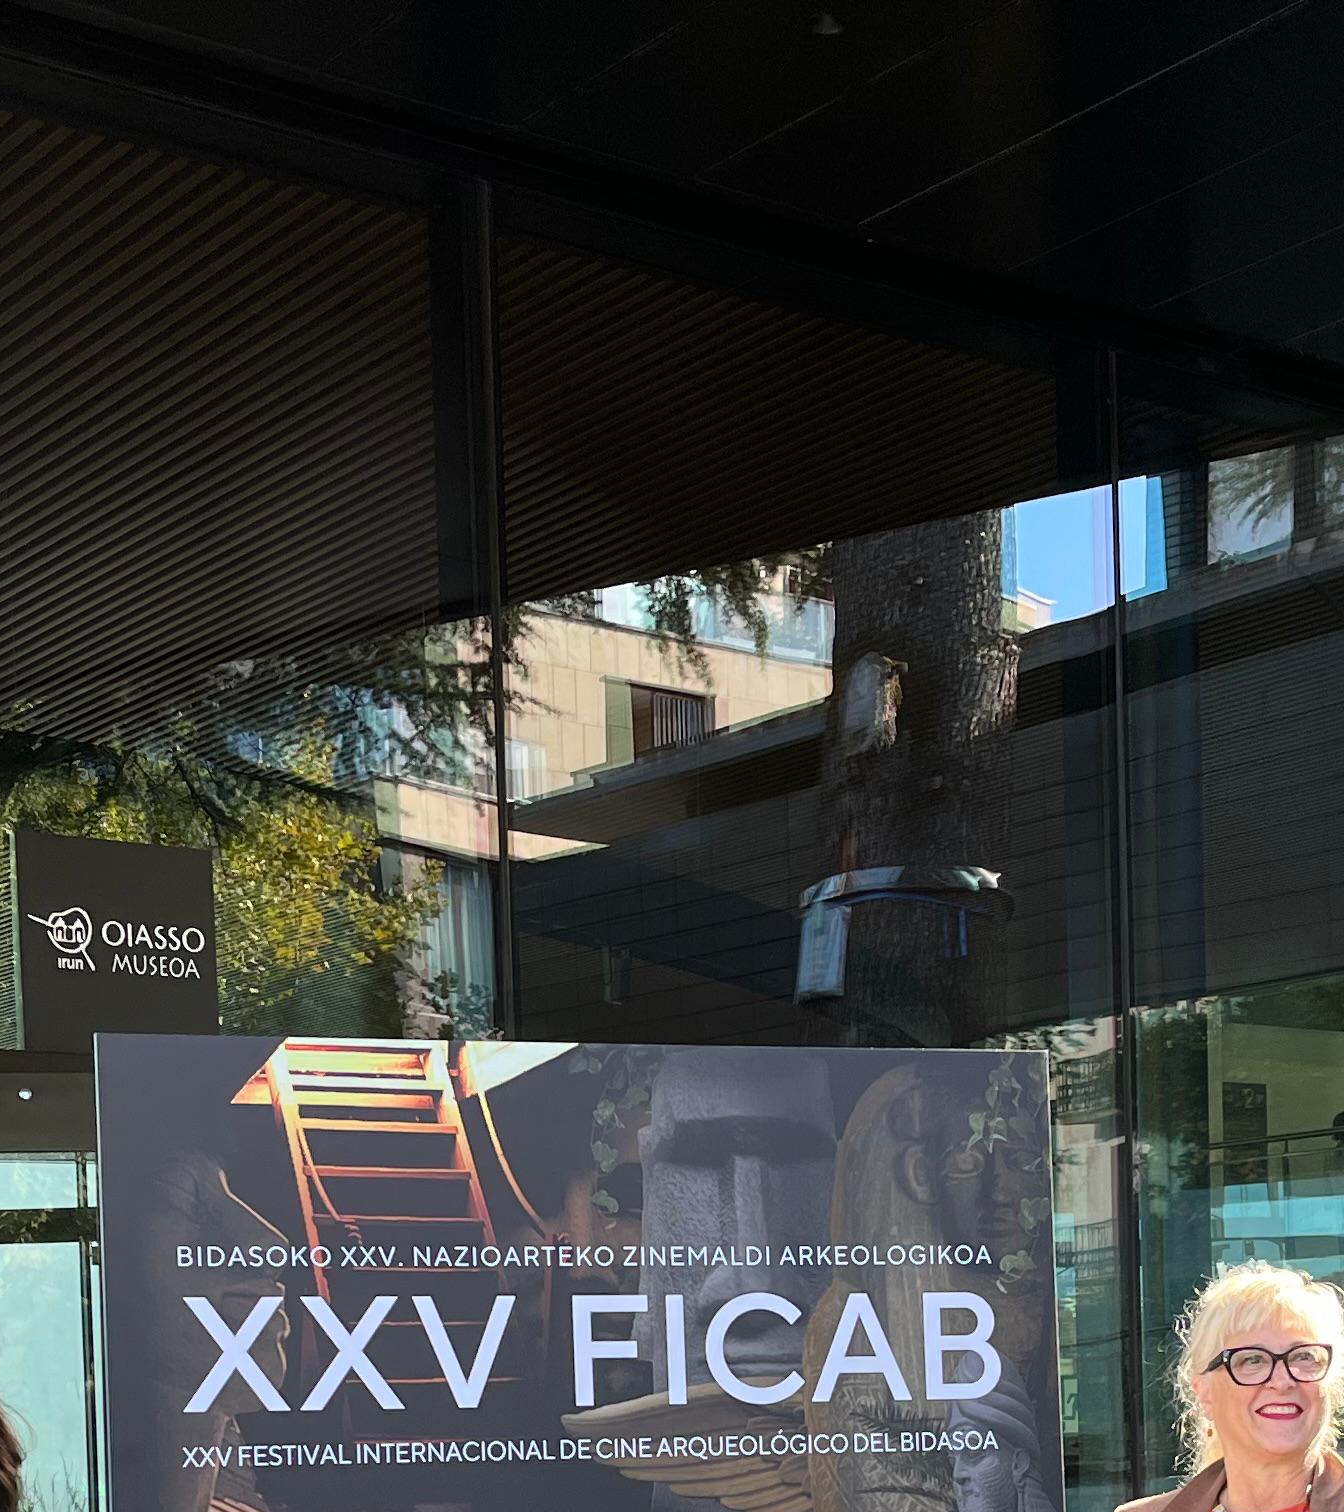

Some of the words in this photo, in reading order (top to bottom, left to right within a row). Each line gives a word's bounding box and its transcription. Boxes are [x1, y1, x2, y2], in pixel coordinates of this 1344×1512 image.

[101, 920, 206, 953] OIASSO
[57, 957, 84, 971] irun
[112, 954, 201, 979] MUSEOA
[176, 1245, 331, 1268] BIDASOKO
[340, 1246, 404, 1267] XXV.
[413, 1245, 614, 1268] NAZIOARTEKO
[623, 1245, 772, 1267] ZINEMALDI
[779, 1244, 993, 1266] ARKEOLOGIKOA
[182, 1295, 517, 1413] XXV
[571, 1291, 1003, 1407] FICAB
[182, 1445, 233, 1468] XXV
[237, 1443, 353, 1467] FESTIVAL
[356, 1439, 556, 1464] INTERNACIONAL
[560, 1438, 592, 1460] DE
[596, 1436, 652, 1459] CINE
[656, 1428, 849, 1459] ARQUEOLÓGICO
[854, 1432, 897, 1453] DEL
[900, 1430, 999, 1452] BIDASOA
